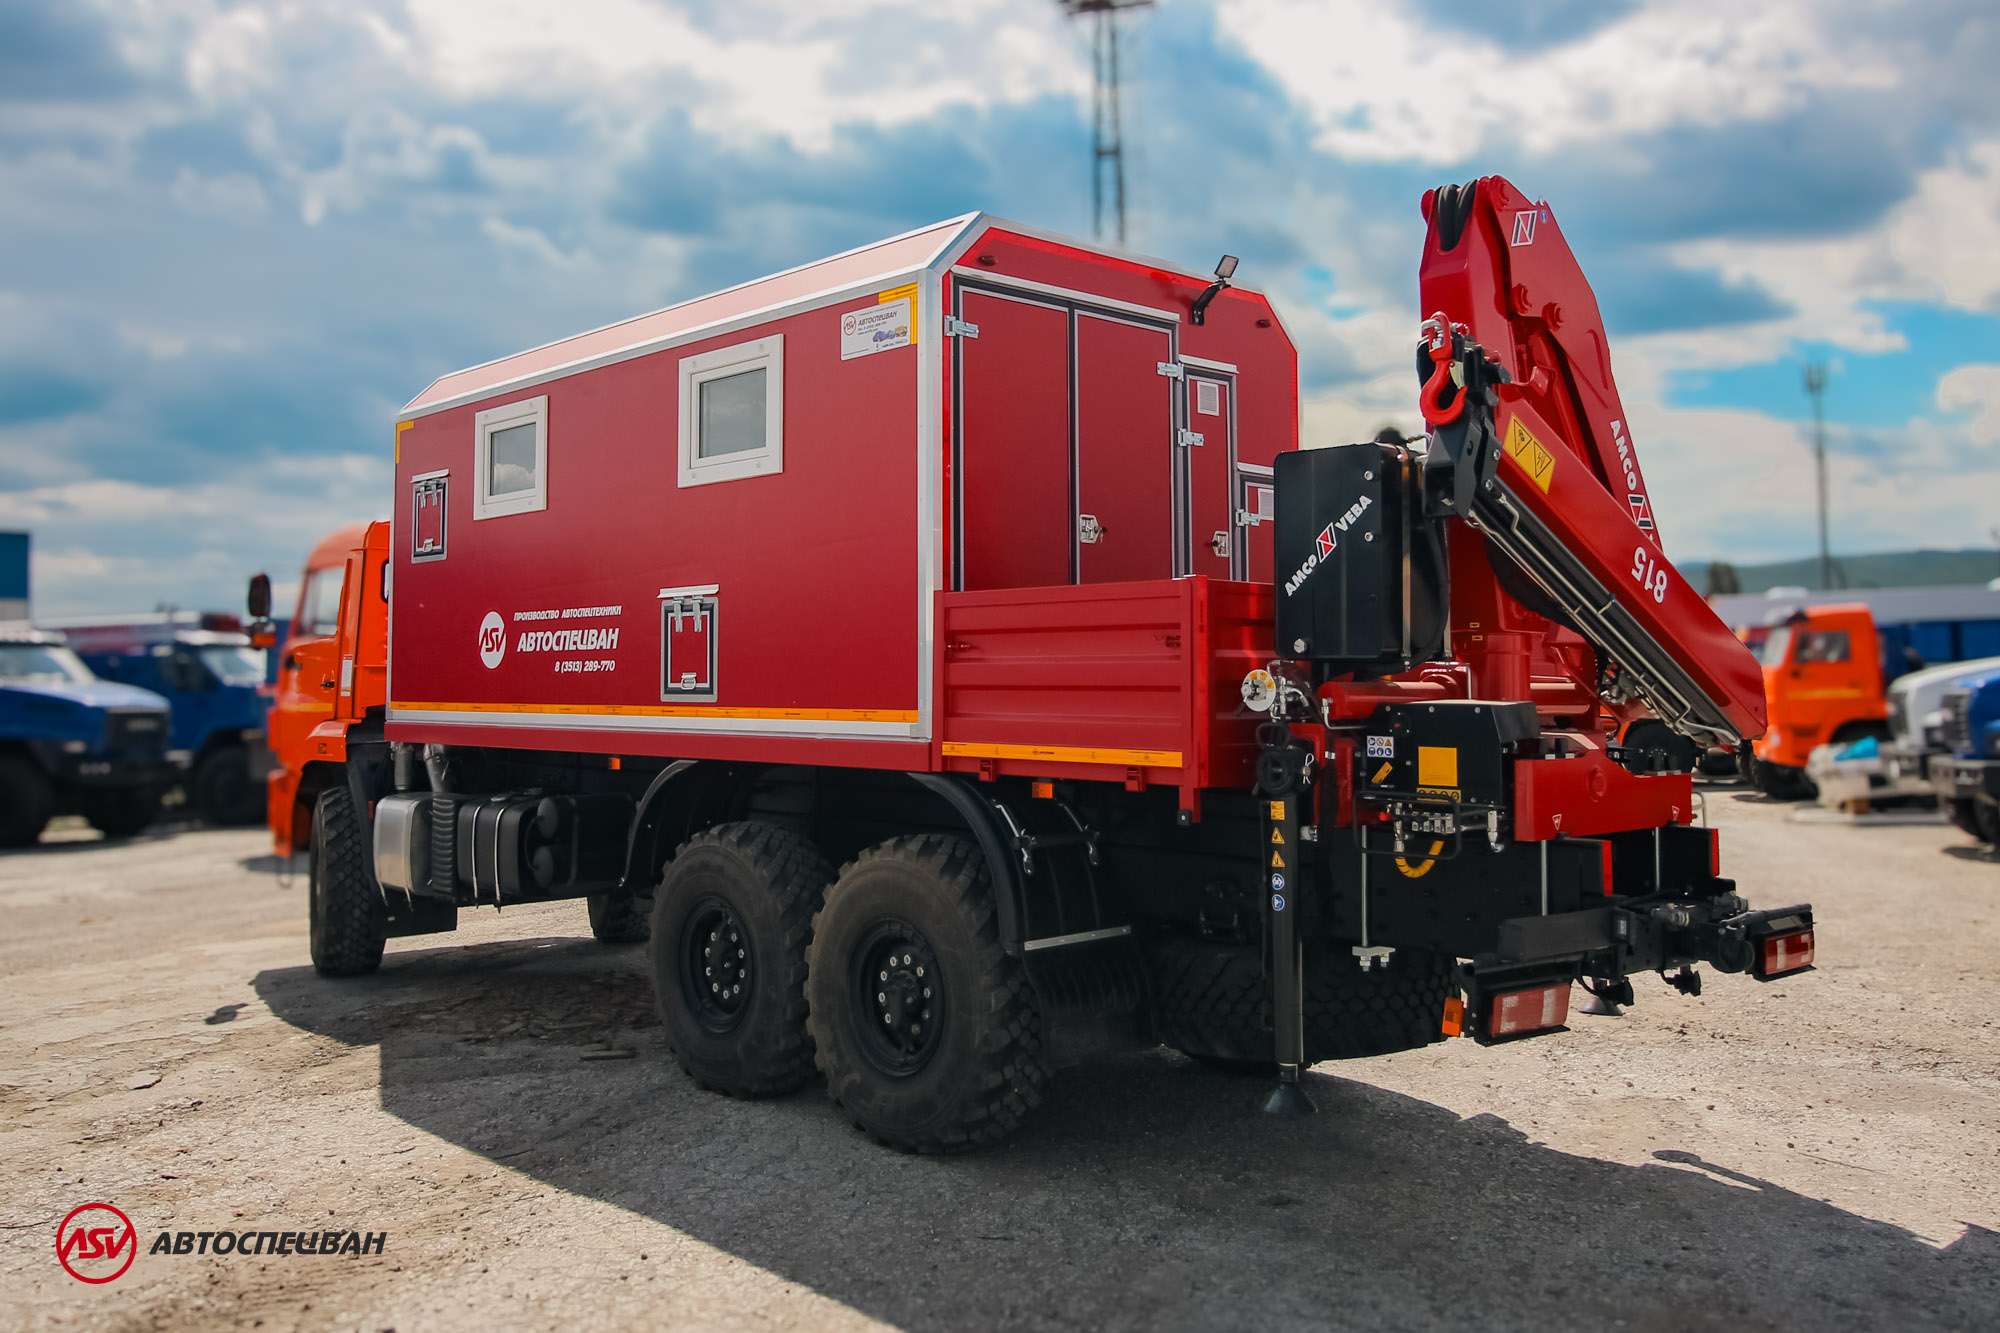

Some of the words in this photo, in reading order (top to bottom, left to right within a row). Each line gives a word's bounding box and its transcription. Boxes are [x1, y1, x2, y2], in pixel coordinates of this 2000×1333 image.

[1610, 420, 1637, 491] AMCO
[1284, 554, 1317, 597] AMCO
[1335, 495, 1373, 532] VEBA
[1632, 546, 1668, 604] 815
[513, 610, 560, 621] ПРОИЗВОДСТВО
[561, 605, 622, 618] АВТОСПЕЦТЕХНИКИ
[516, 628, 620, 652] АВТОСПЕЦВАН
[554, 661, 561, 672] 8
[561, 661, 582, 673] (3513)
[583, 660, 616, 672] 289-770
